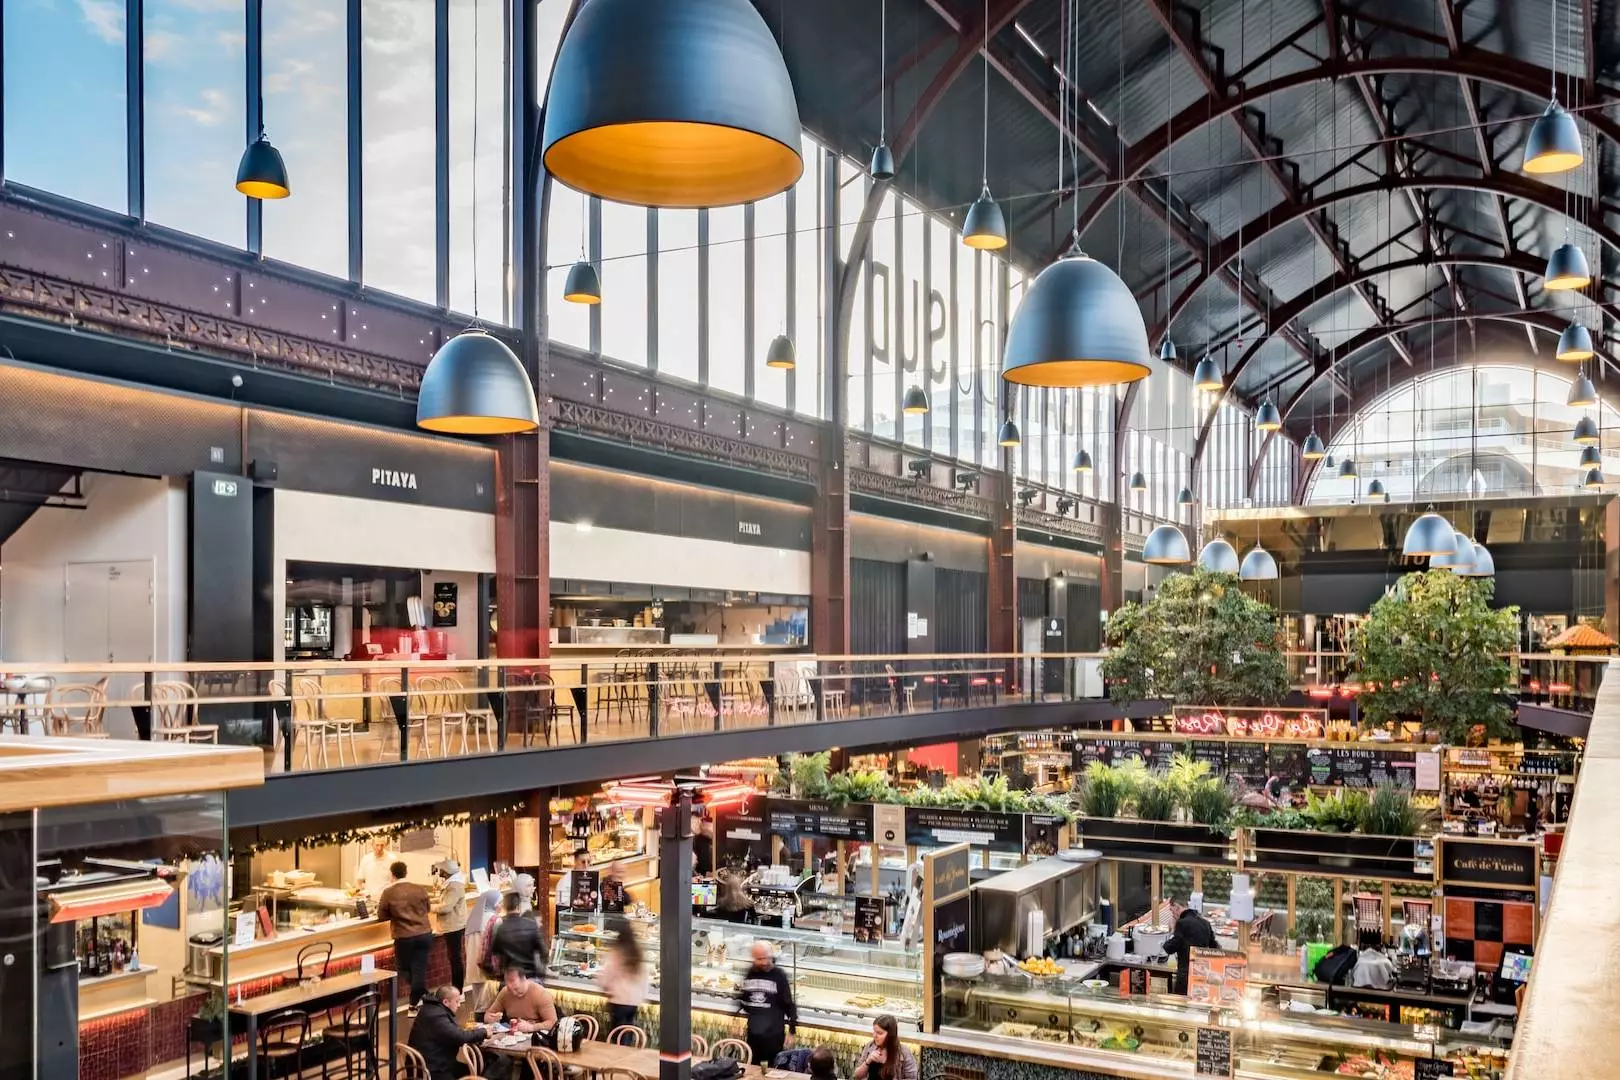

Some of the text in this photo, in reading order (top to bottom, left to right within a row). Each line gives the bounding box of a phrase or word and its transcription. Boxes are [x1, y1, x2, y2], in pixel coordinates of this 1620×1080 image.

[371, 467, 418, 490] PITAYA
[738, 521, 762, 536] PITAYA
[1453, 859, 1524, 873] Café de Turin
